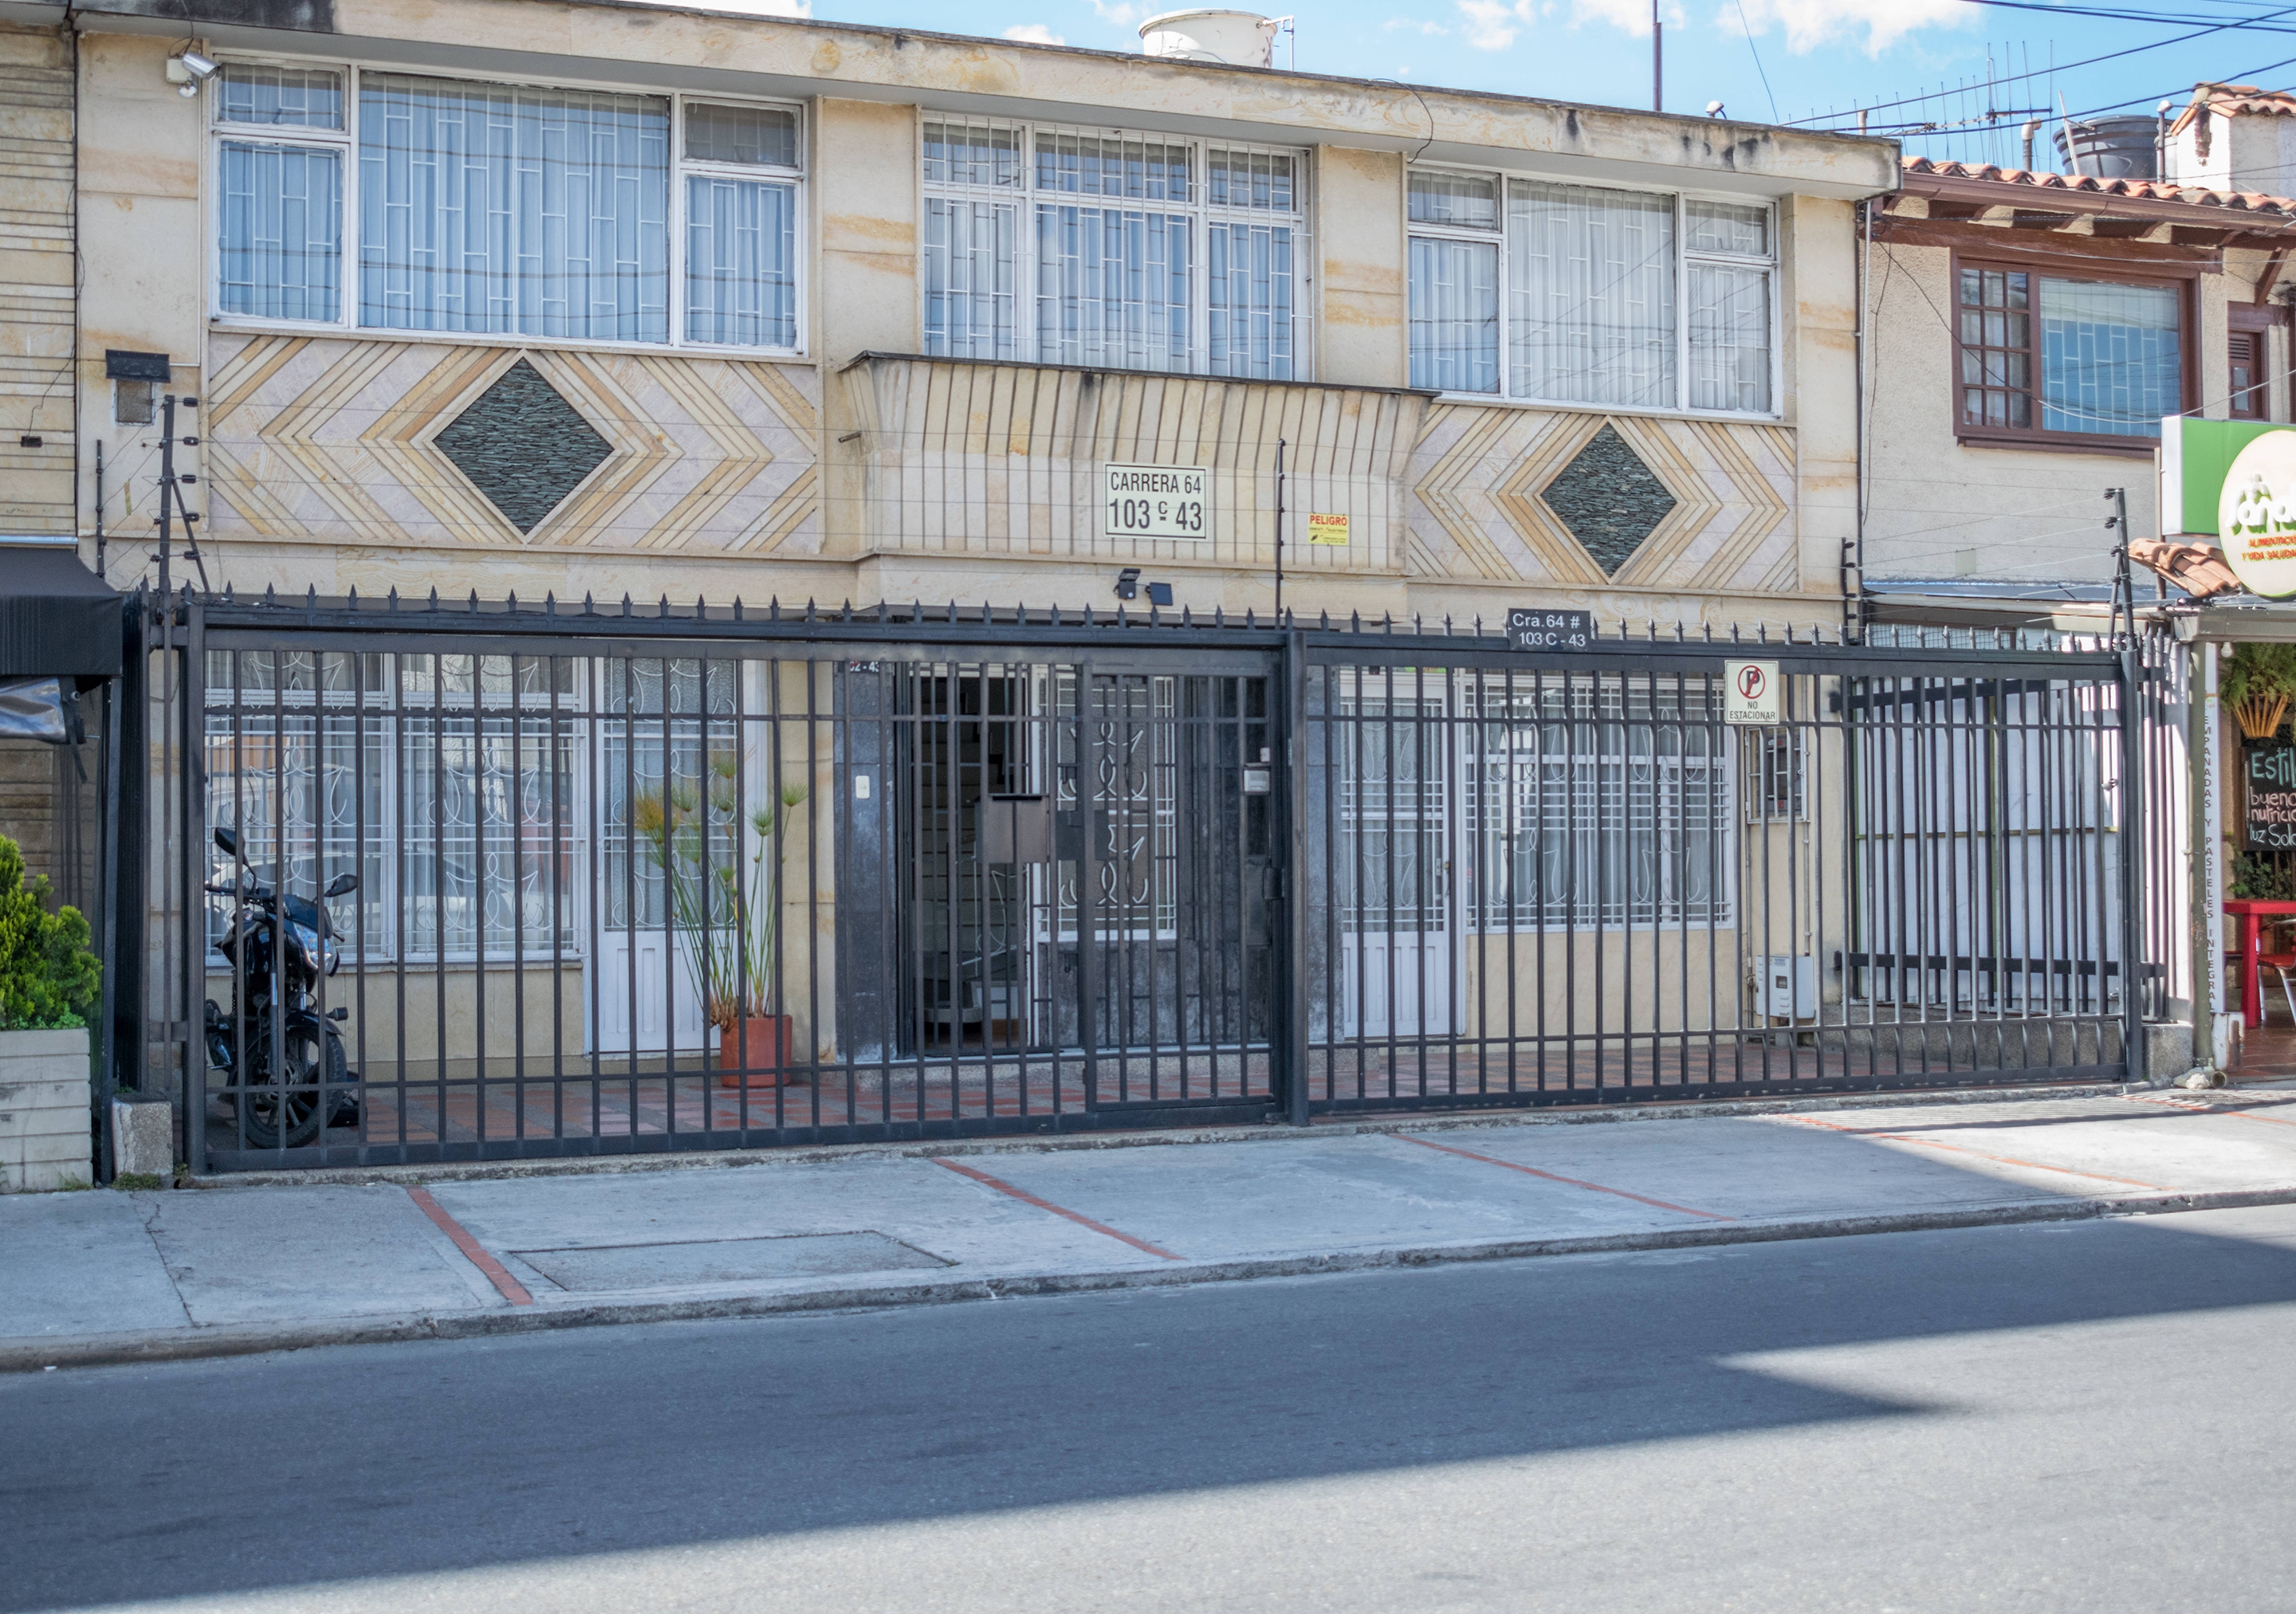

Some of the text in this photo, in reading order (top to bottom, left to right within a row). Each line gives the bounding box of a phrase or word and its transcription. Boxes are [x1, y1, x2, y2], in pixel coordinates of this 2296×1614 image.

[1111, 472, 1201, 494] CARRERA 64
[1109, 498, 1150, 529] 103
[1175, 501, 1202, 532] 43
[1310, 515, 1347, 526] PELIGRO
[2248, 551, 2265, 561] VIDA
[1546, 615, 1565, 628] 64
[1570, 615, 1581, 629] #
[1519, 631, 1543, 646] 103
[1568, 634, 1586, 647] 43
[1748, 701, 1758, 709] NO
[1729, 710, 1776, 720] ESTACIONAR
[2204, 818, 2212, 827] Y
[2250, 823, 2266, 843] luz
[2205, 836, 2214, 919] PASTELES
